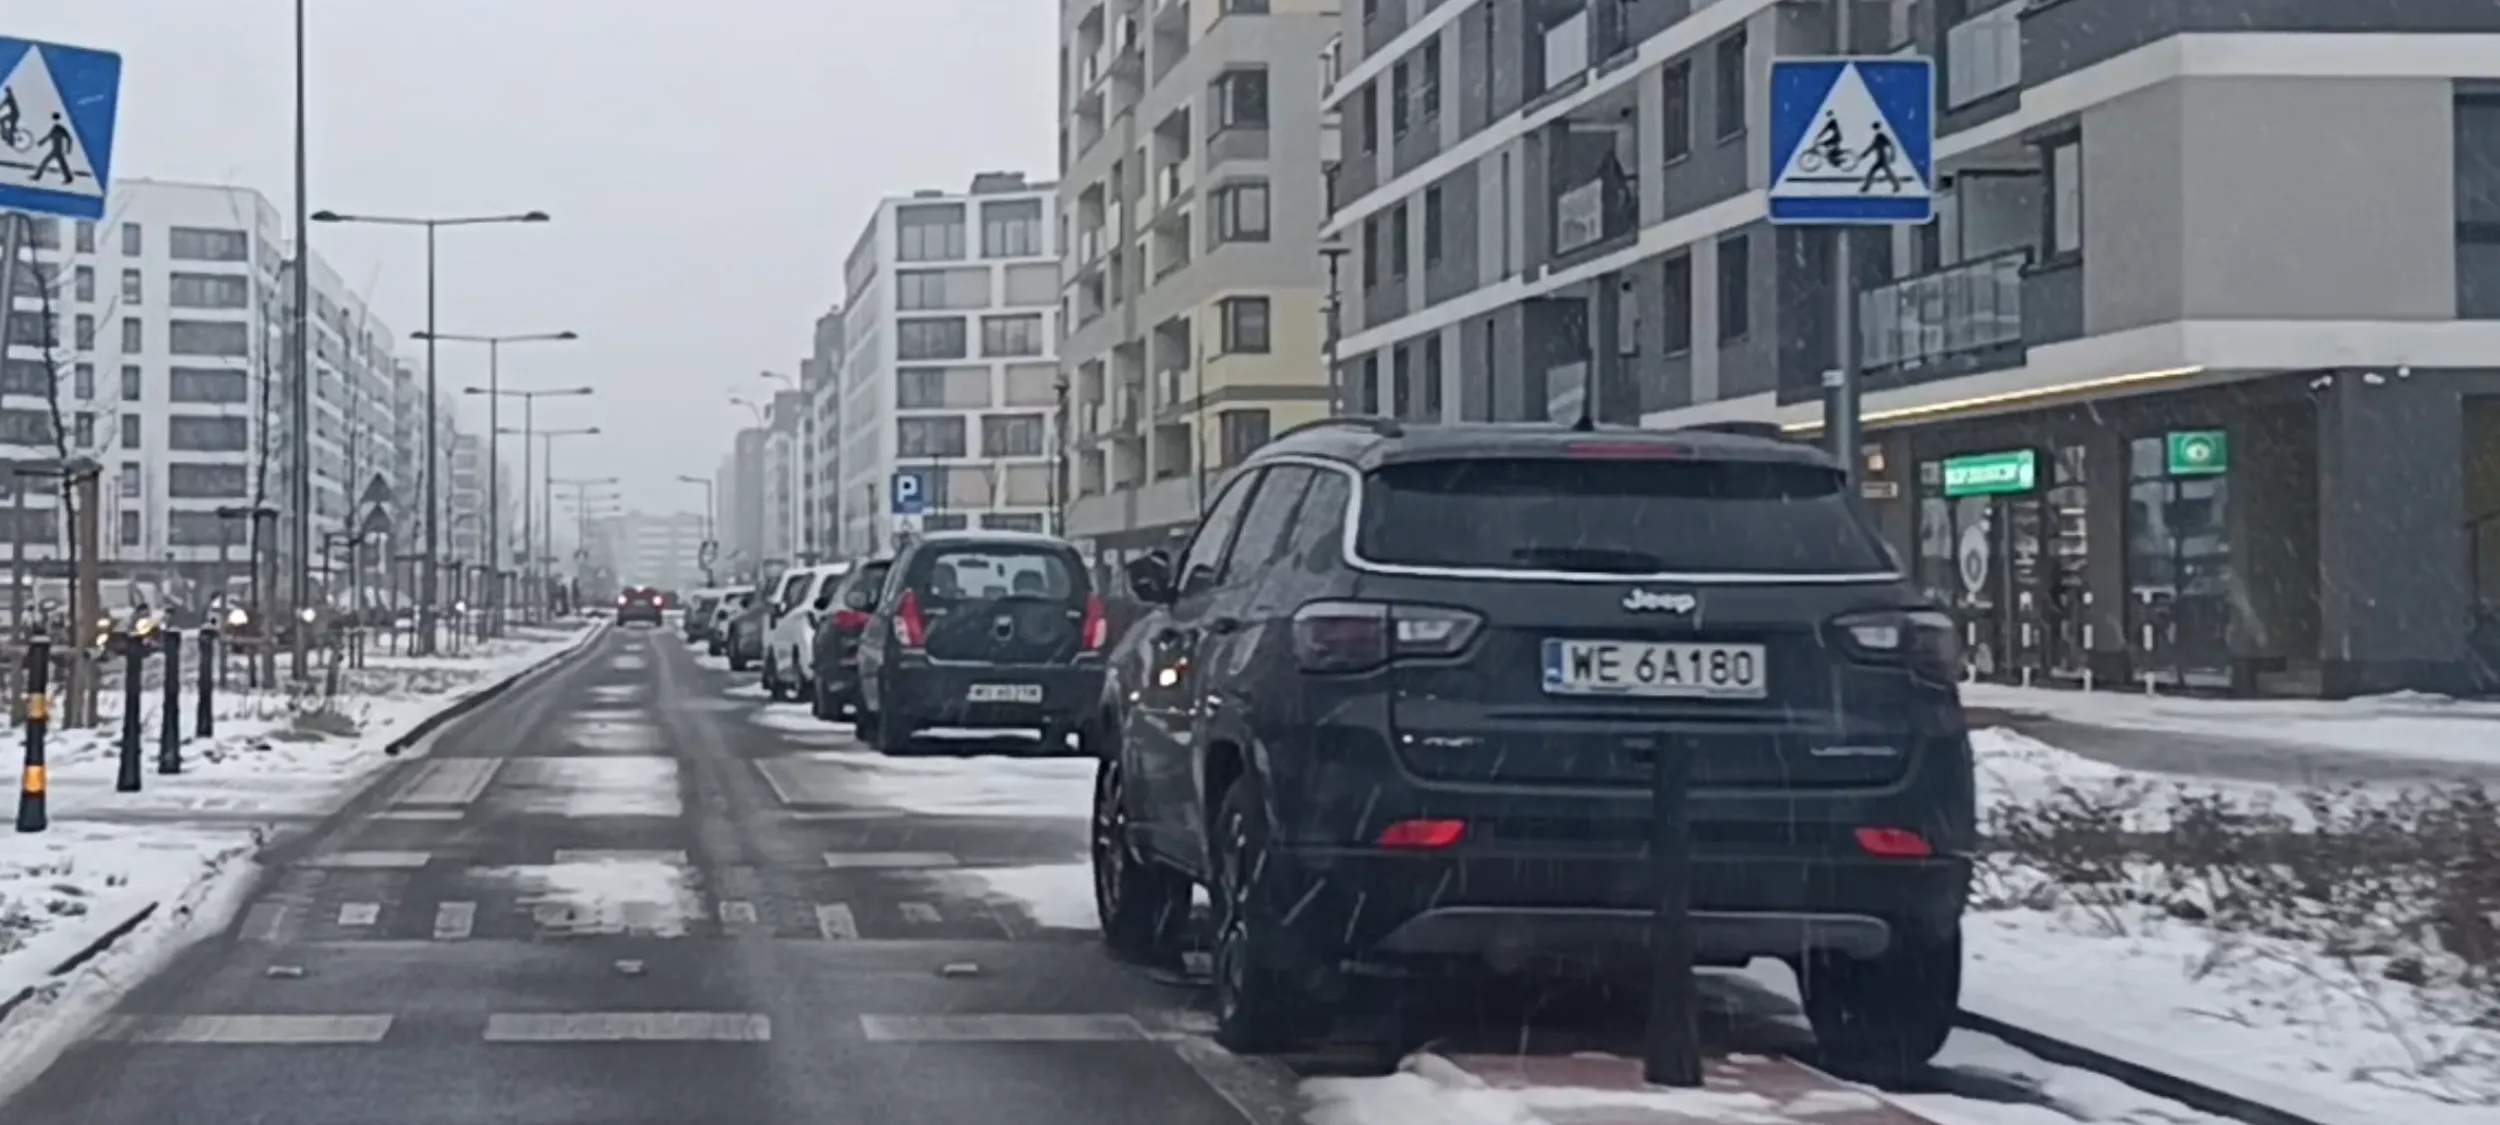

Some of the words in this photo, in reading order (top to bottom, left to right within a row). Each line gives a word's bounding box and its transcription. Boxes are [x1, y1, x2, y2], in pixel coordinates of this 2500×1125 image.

[897, 474, 918, 504] P
[1622, 587, 1696, 614] Jeep
[1571, 646, 1621, 682] WE
[1635, 647, 1754, 686] 6A180
